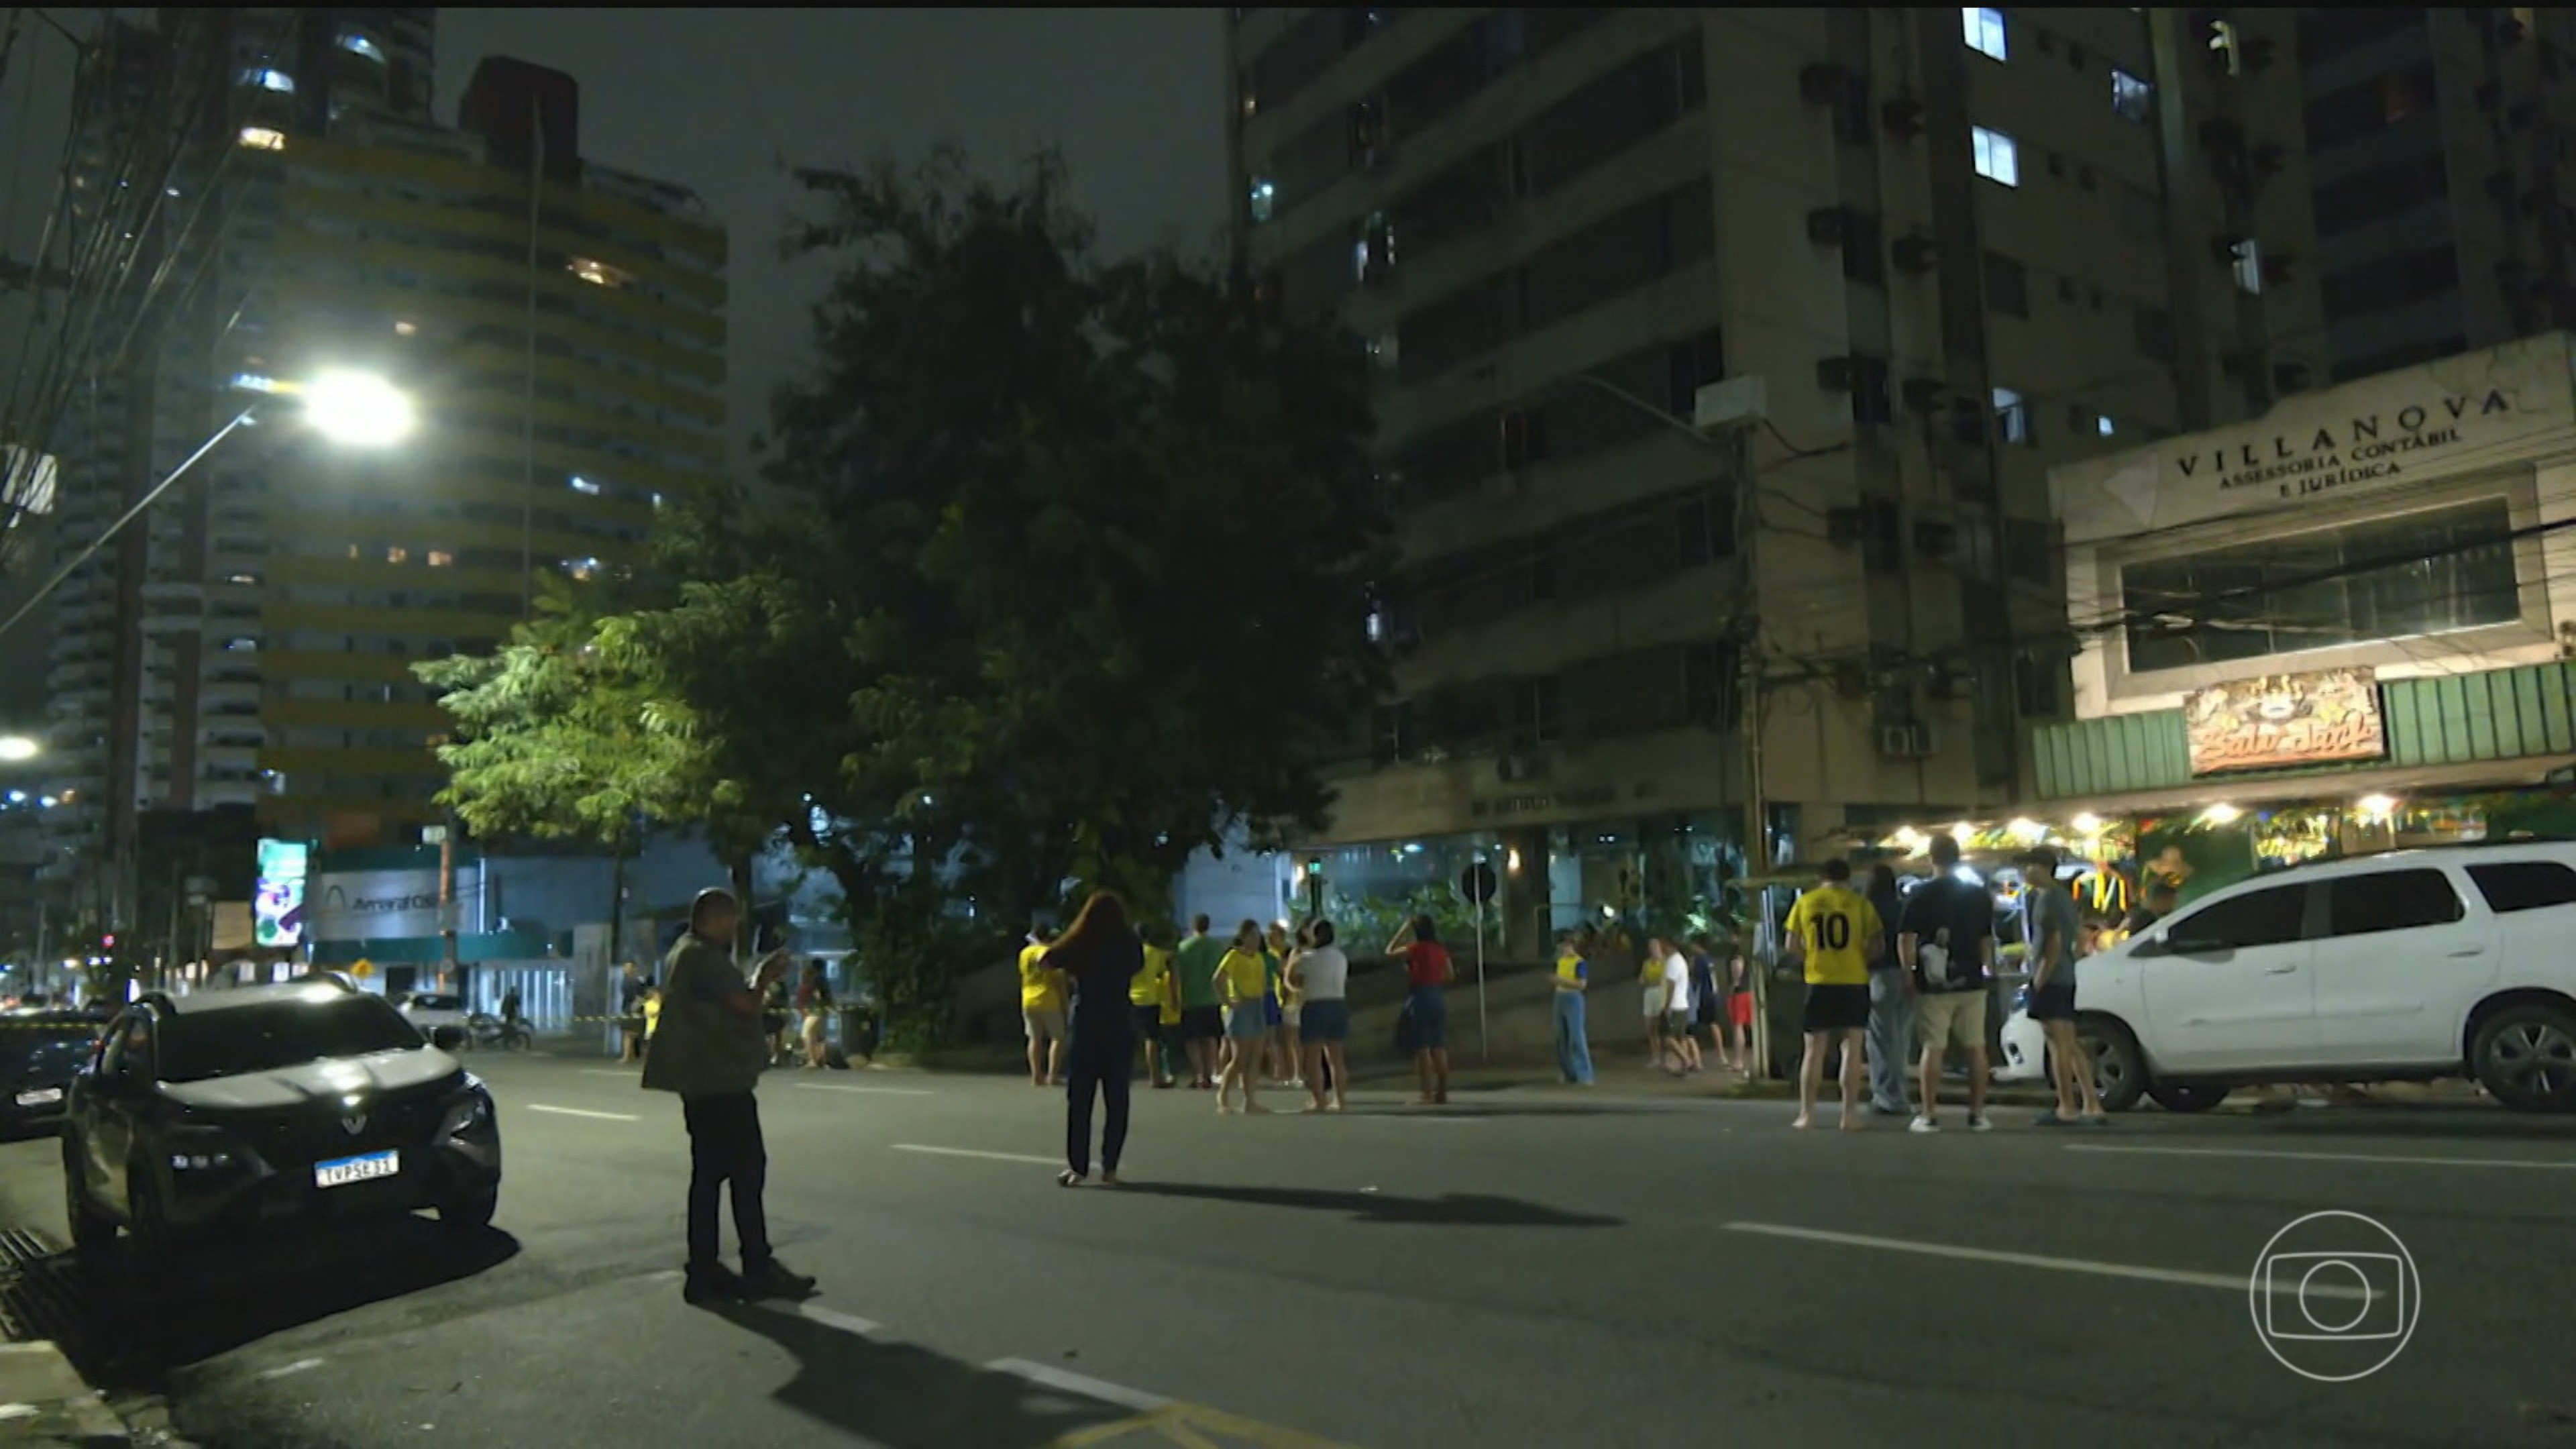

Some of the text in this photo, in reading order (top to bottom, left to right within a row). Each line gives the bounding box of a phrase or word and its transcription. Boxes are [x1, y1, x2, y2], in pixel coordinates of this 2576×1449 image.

[2178, 388, 2509, 477] VILLANOVA
[2219, 428, 2462, 490] ASSESSORIA CONTÁBIL
[2279, 461, 2402, 498] E JURÍDICA
[1810, 912, 1850, 951] 10
